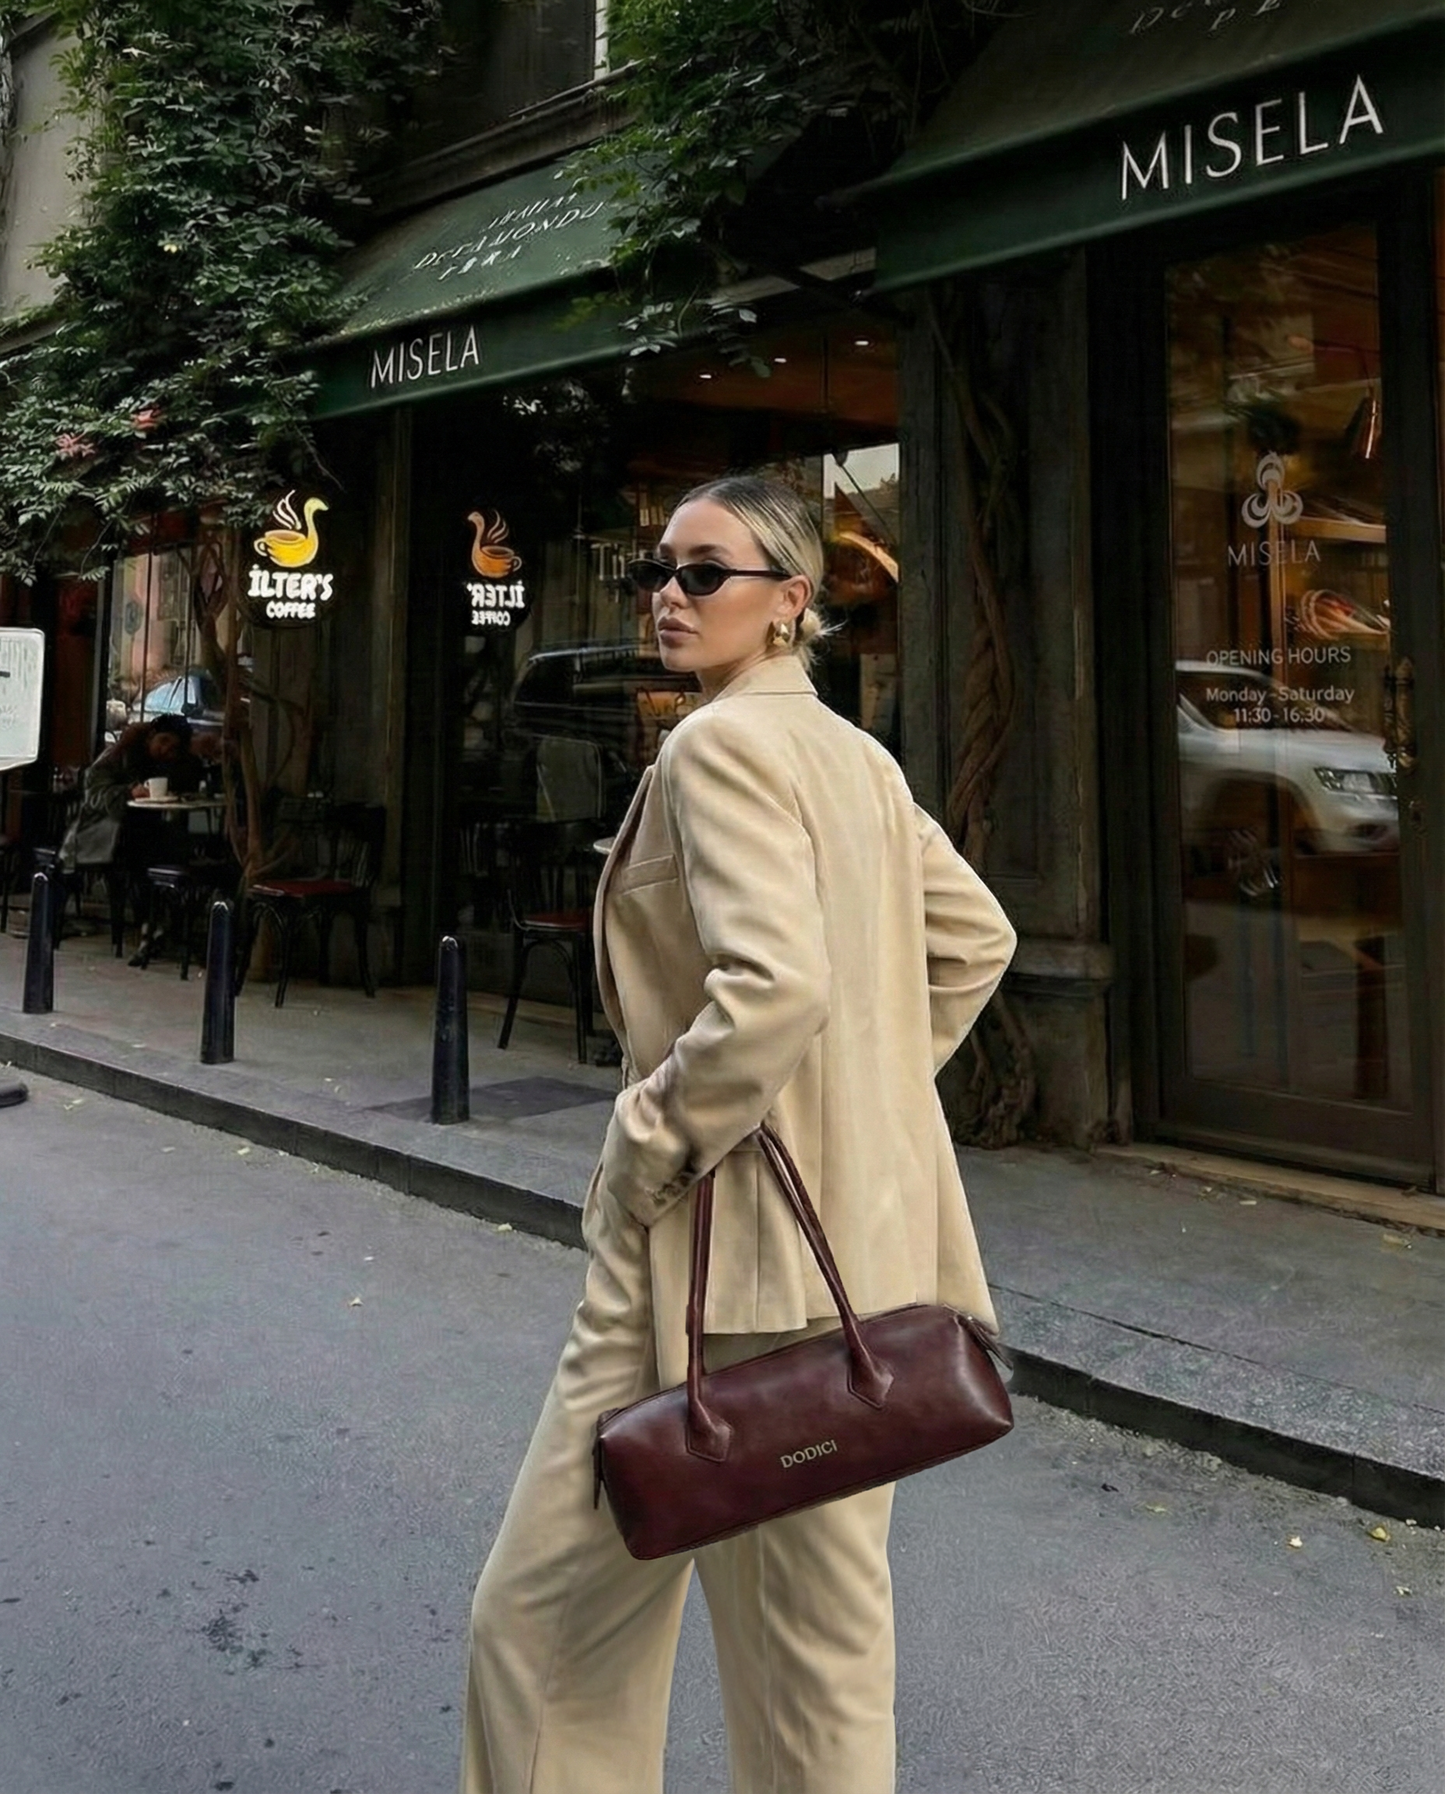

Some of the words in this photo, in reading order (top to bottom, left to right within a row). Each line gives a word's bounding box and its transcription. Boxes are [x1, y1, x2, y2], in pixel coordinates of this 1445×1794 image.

[1122, 74, 1383, 200] MISELA
[371, 325, 479, 388] MISELA
[1228, 540, 1321, 567] MISELA
[266, 601, 316, 619] COFFEE
[1206, 650, 1284, 666] OPENING
[1288, 647, 1352, 664] HOURS
[1206, 687, 1267, 706] Monday
[1278, 685, 1355, 704] Saturday
[1234, 708, 1271, 723] 11:30
[1283, 707, 1326, 723] 16:30
[780, 1439, 838, 1468] DODICI
